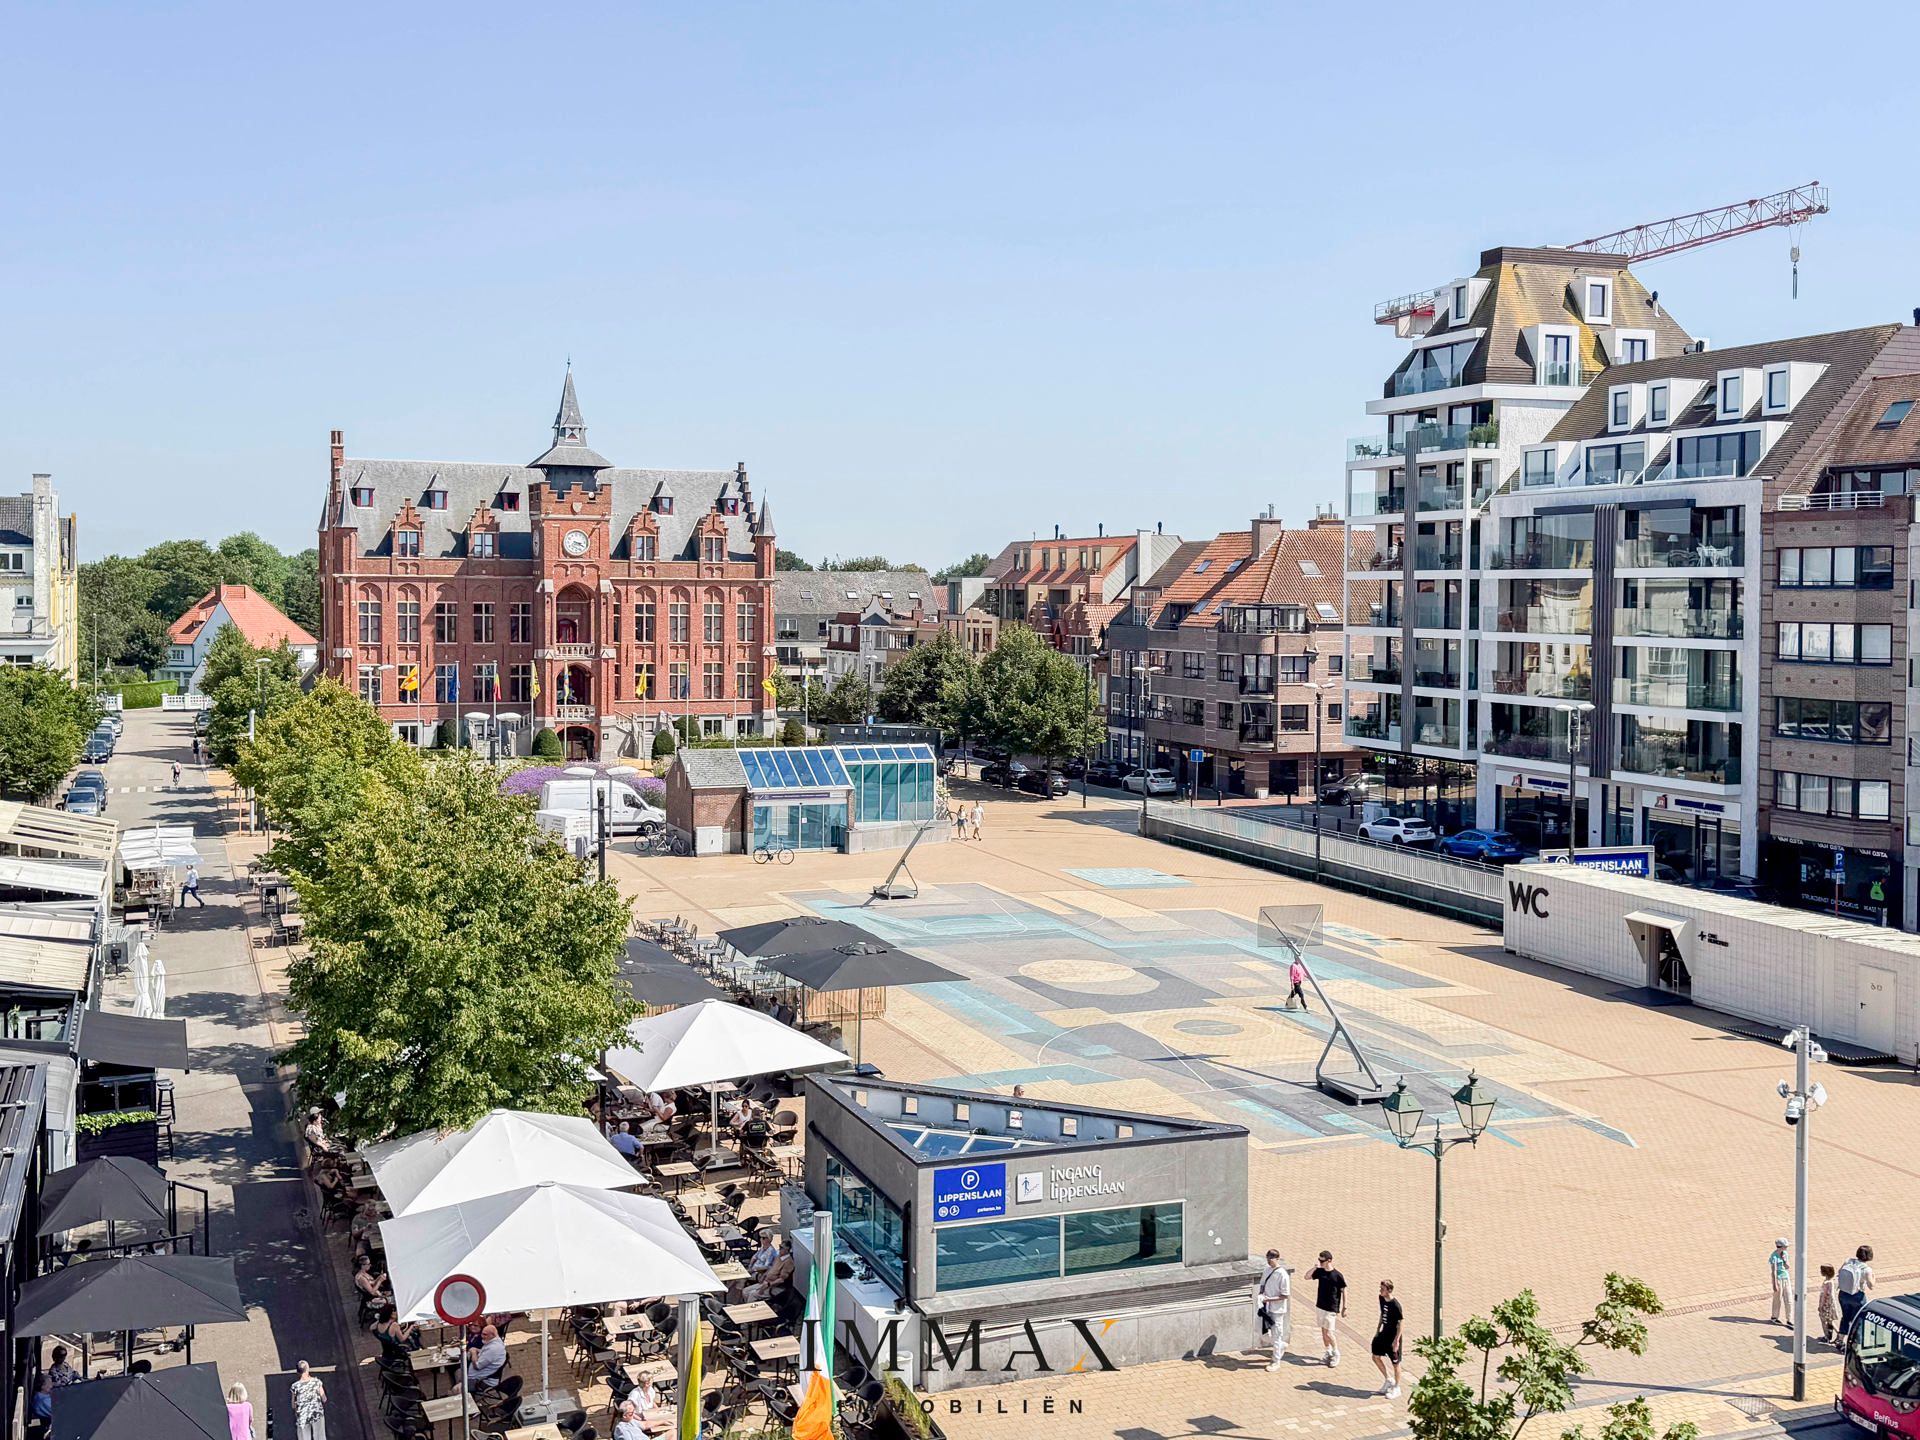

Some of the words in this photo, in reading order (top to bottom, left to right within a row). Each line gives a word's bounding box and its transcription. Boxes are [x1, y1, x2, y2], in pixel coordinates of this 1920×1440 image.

[1835, 853, 1843, 865] P
[1509, 881, 1549, 918] WC
[966, 1174, 975, 1186] P
[938, 1188, 1002, 1203] LIPPENSLAAN
[1865, 1311, 1886, 1326] 100%
[1873, 1410, 1899, 1429] Belfius
